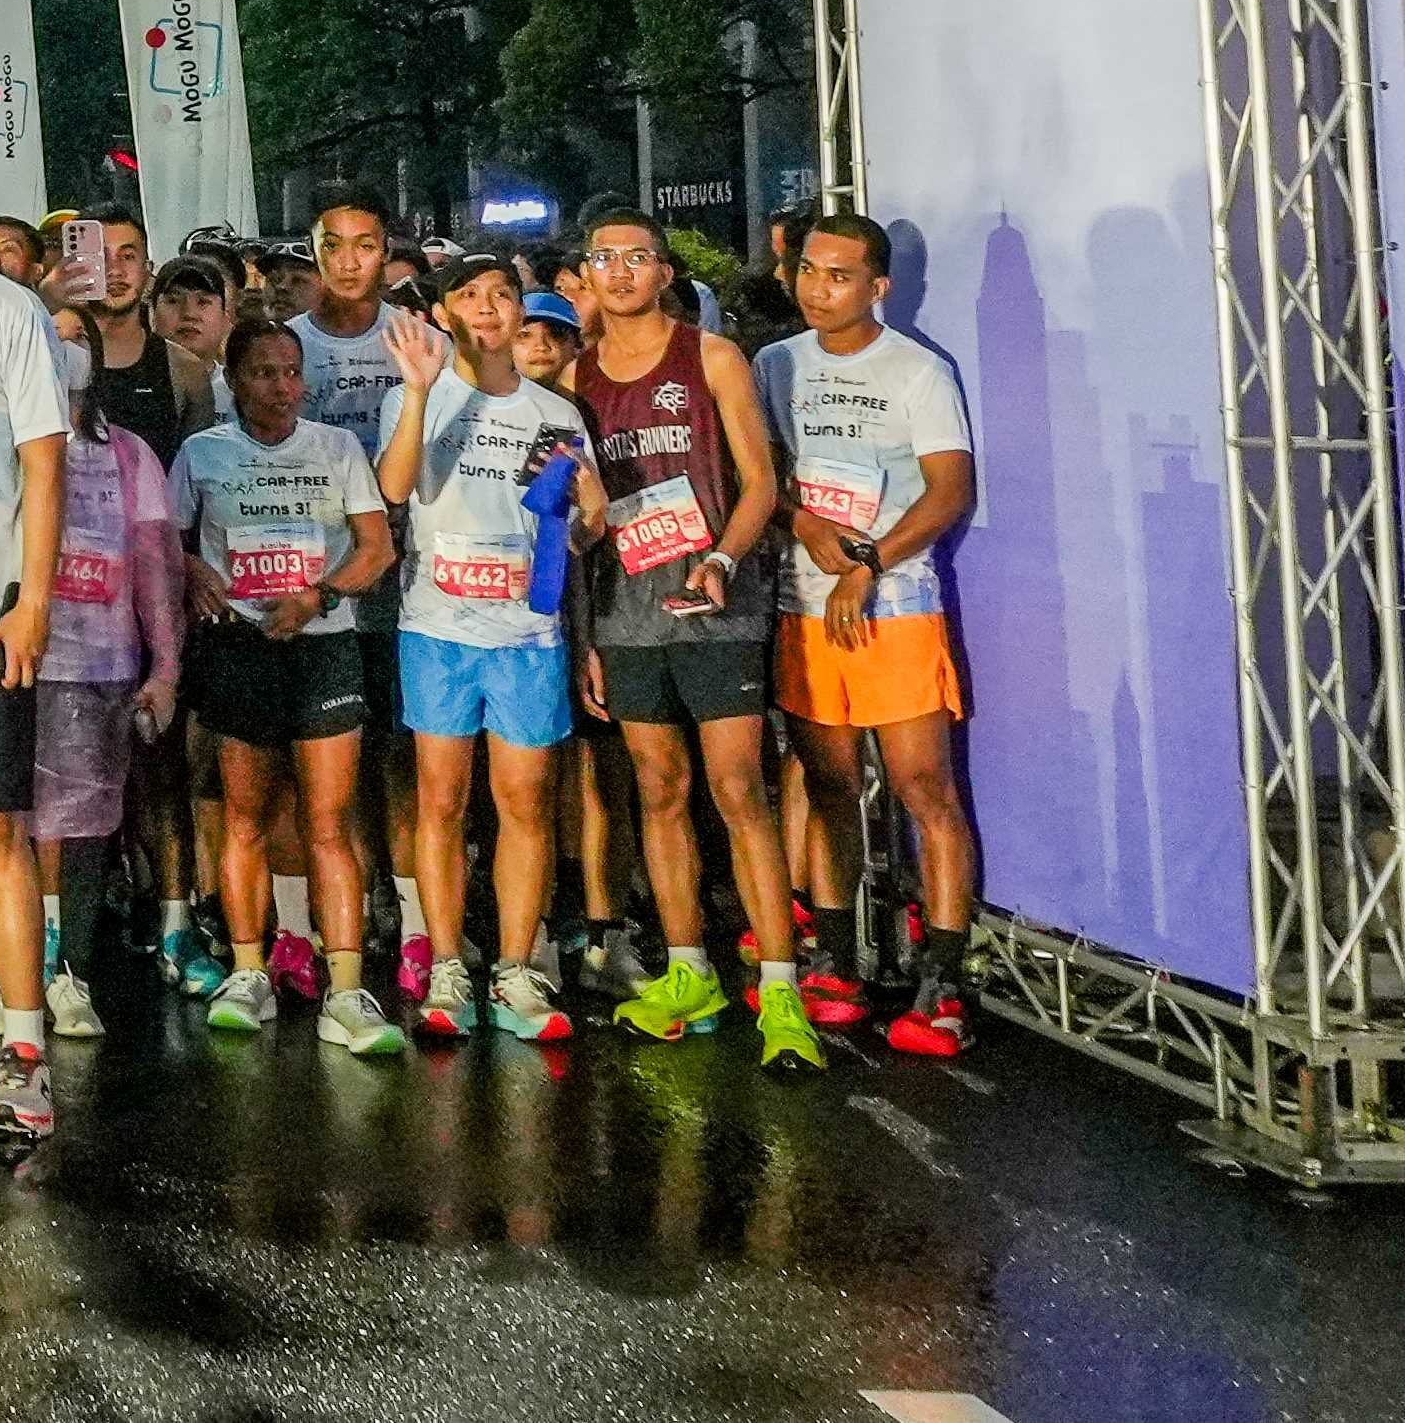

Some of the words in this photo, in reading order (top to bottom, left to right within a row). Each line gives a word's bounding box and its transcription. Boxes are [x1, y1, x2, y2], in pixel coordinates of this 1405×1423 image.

[657, 179, 733, 209] STARBUCKS
[336, 376, 404, 390] CAR-FRE
[639, 425, 692, 456] RUNNERS
[848, 424, 862, 439] 3!
[256, 476, 330, 487] CAR-FREE
[459, 462, 506, 481] turns
[239, 501, 290, 516] turns
[295, 502, 311, 516] 3!
[616, 514, 678, 553] 61085
[232, 553, 302, 578] 61003
[434, 563, 507, 588] 61462
